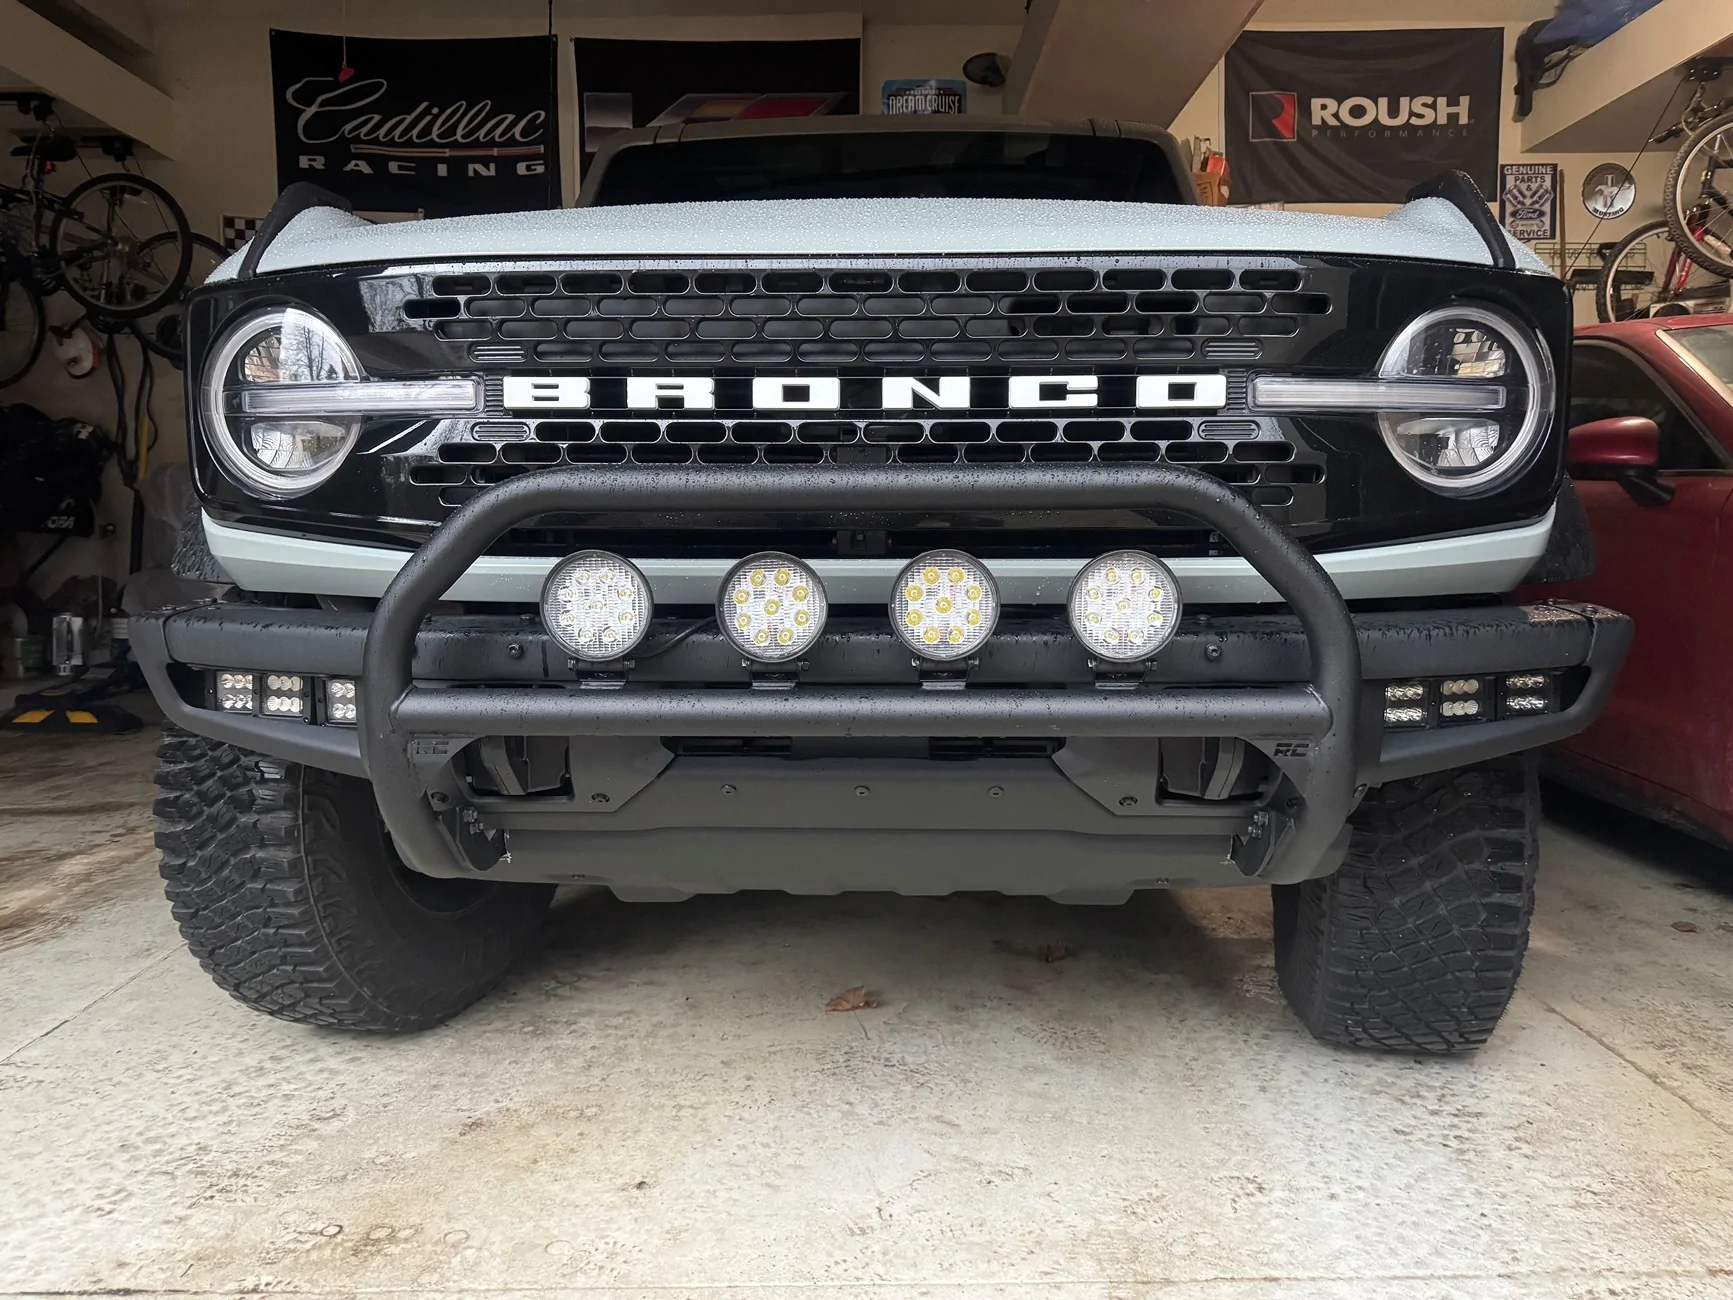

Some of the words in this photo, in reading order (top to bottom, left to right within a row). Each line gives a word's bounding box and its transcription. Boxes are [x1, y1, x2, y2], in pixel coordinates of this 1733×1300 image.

[286, 77, 546, 143] Cadillac
[1310, 95, 1471, 127] ROUSH
[1312, 128, 1470, 138] PERFORMANCE
[299, 155, 546, 177] RACING
[1504, 165, 1554, 174] GENUINE
[1514, 175, 1546, 184] PARTS
[1516, 208, 1539, 219] Ford
[503, 374, 1228, 411] BRONCO
[1273, 742, 1310, 757] RC
